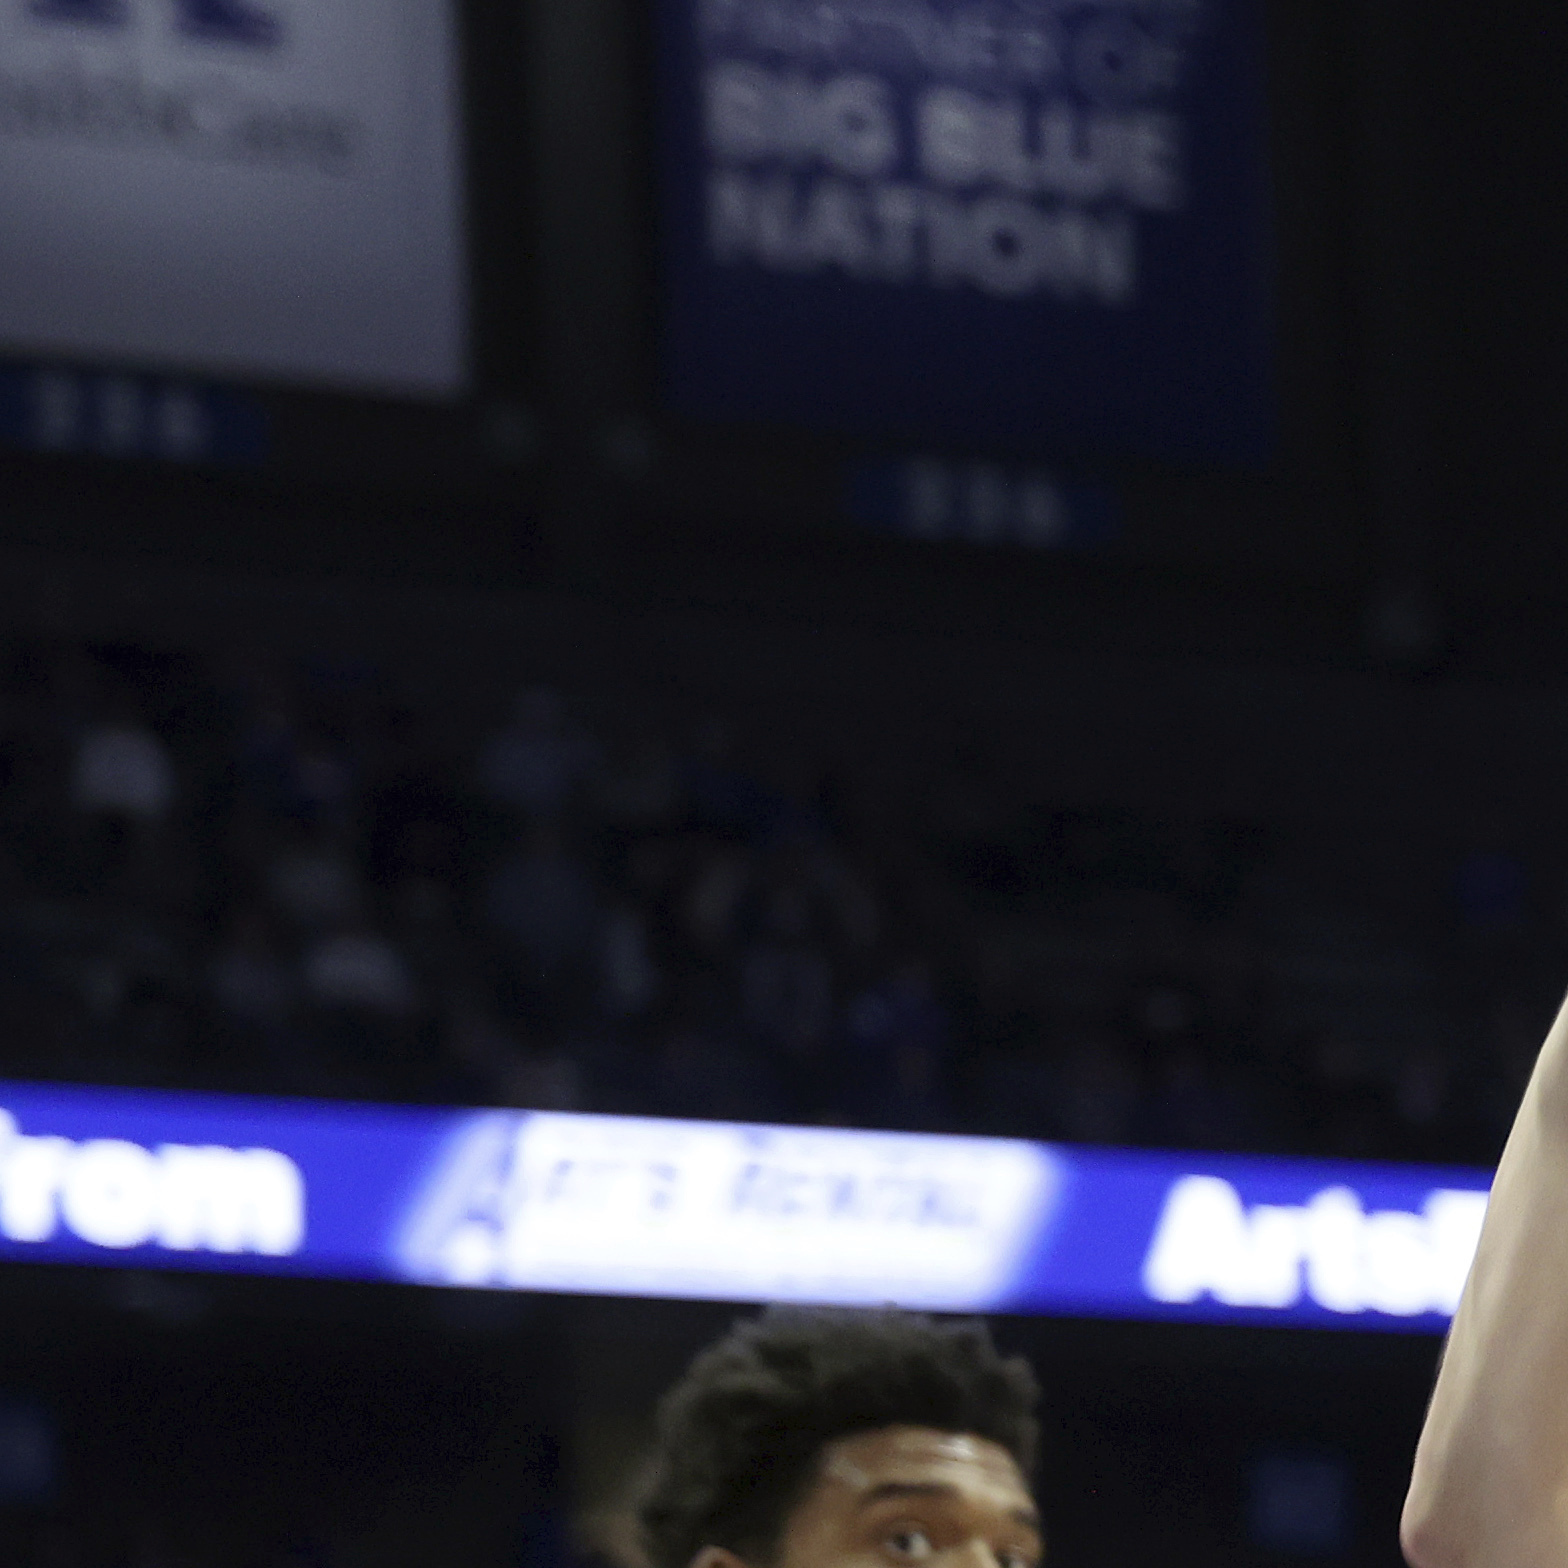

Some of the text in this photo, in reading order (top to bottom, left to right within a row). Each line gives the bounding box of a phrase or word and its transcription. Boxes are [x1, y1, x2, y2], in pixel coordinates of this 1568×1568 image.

[704, 60, 1188, 212] BIG BLUE
[706, 165, 1142, 308] NATION
[0, 1105, 306, 1255] rom
